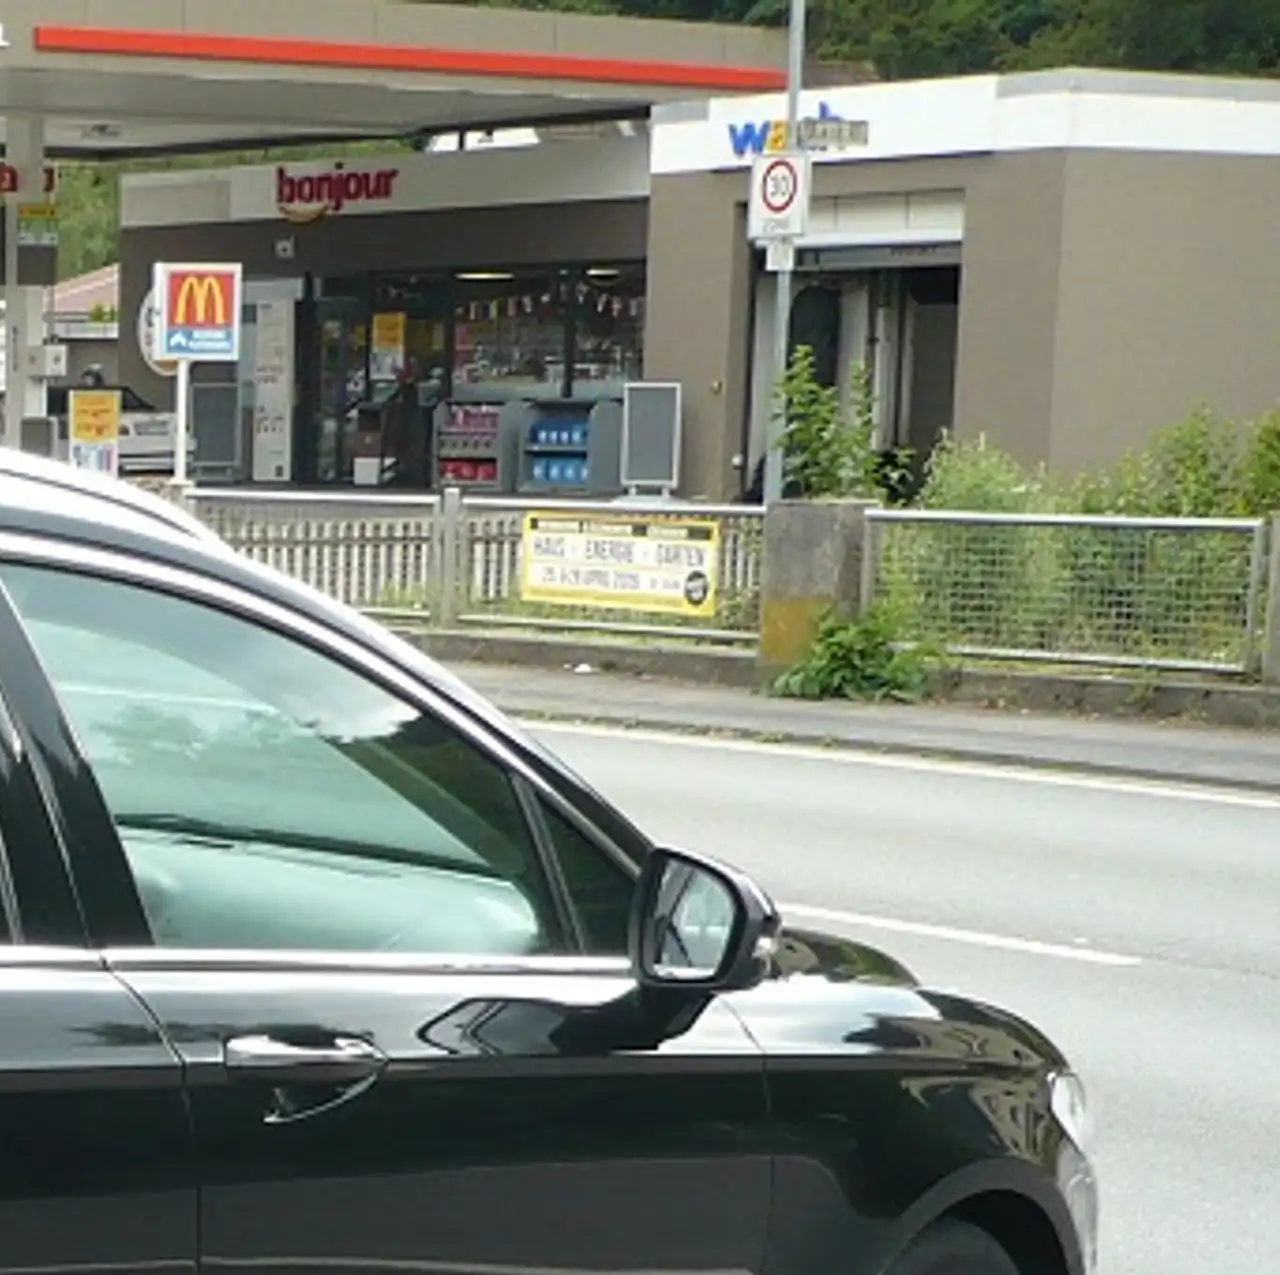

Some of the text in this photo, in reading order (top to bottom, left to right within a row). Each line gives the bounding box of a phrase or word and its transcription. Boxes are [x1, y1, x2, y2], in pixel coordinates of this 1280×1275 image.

[277, 161, 399, 211] bonjour
[770, 174, 790, 198] 30
[586, 539, 635, 563] ENERGIE
[657, 543, 704, 567] GARTEN
